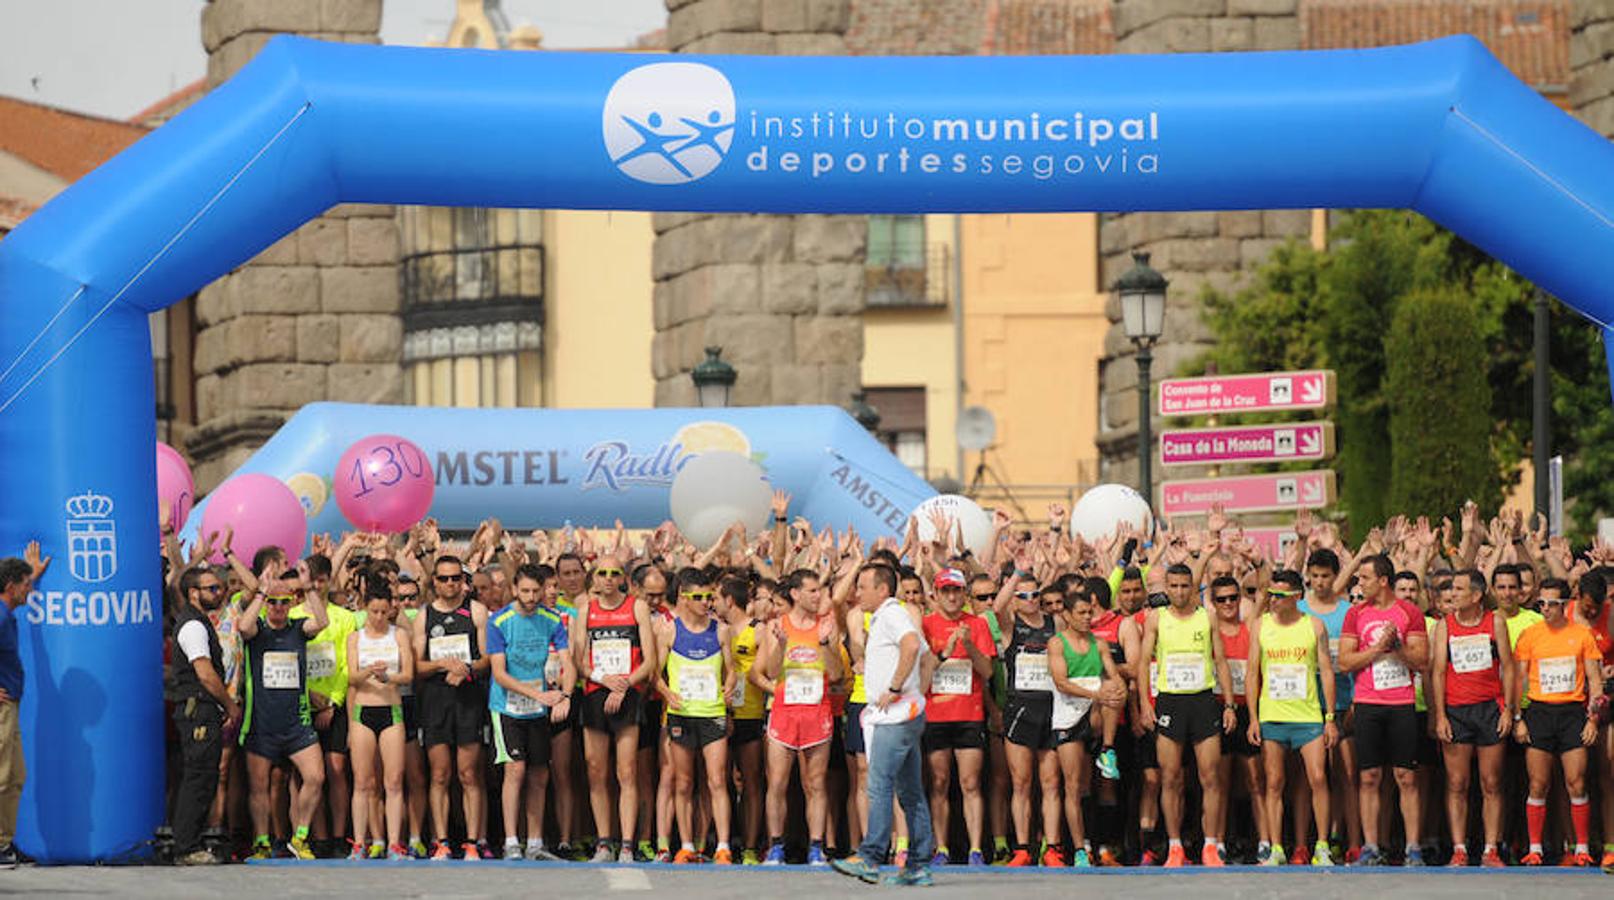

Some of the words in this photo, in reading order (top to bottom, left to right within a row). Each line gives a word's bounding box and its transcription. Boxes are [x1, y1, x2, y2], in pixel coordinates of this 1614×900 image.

[1165, 441, 1194, 456] Casa
[1195, 439, 1211, 454] de
[1228, 437, 1272, 452] Moneda
[434, 449, 569, 487] MSTEL
[26, 589, 153, 625] SEGOVIA
